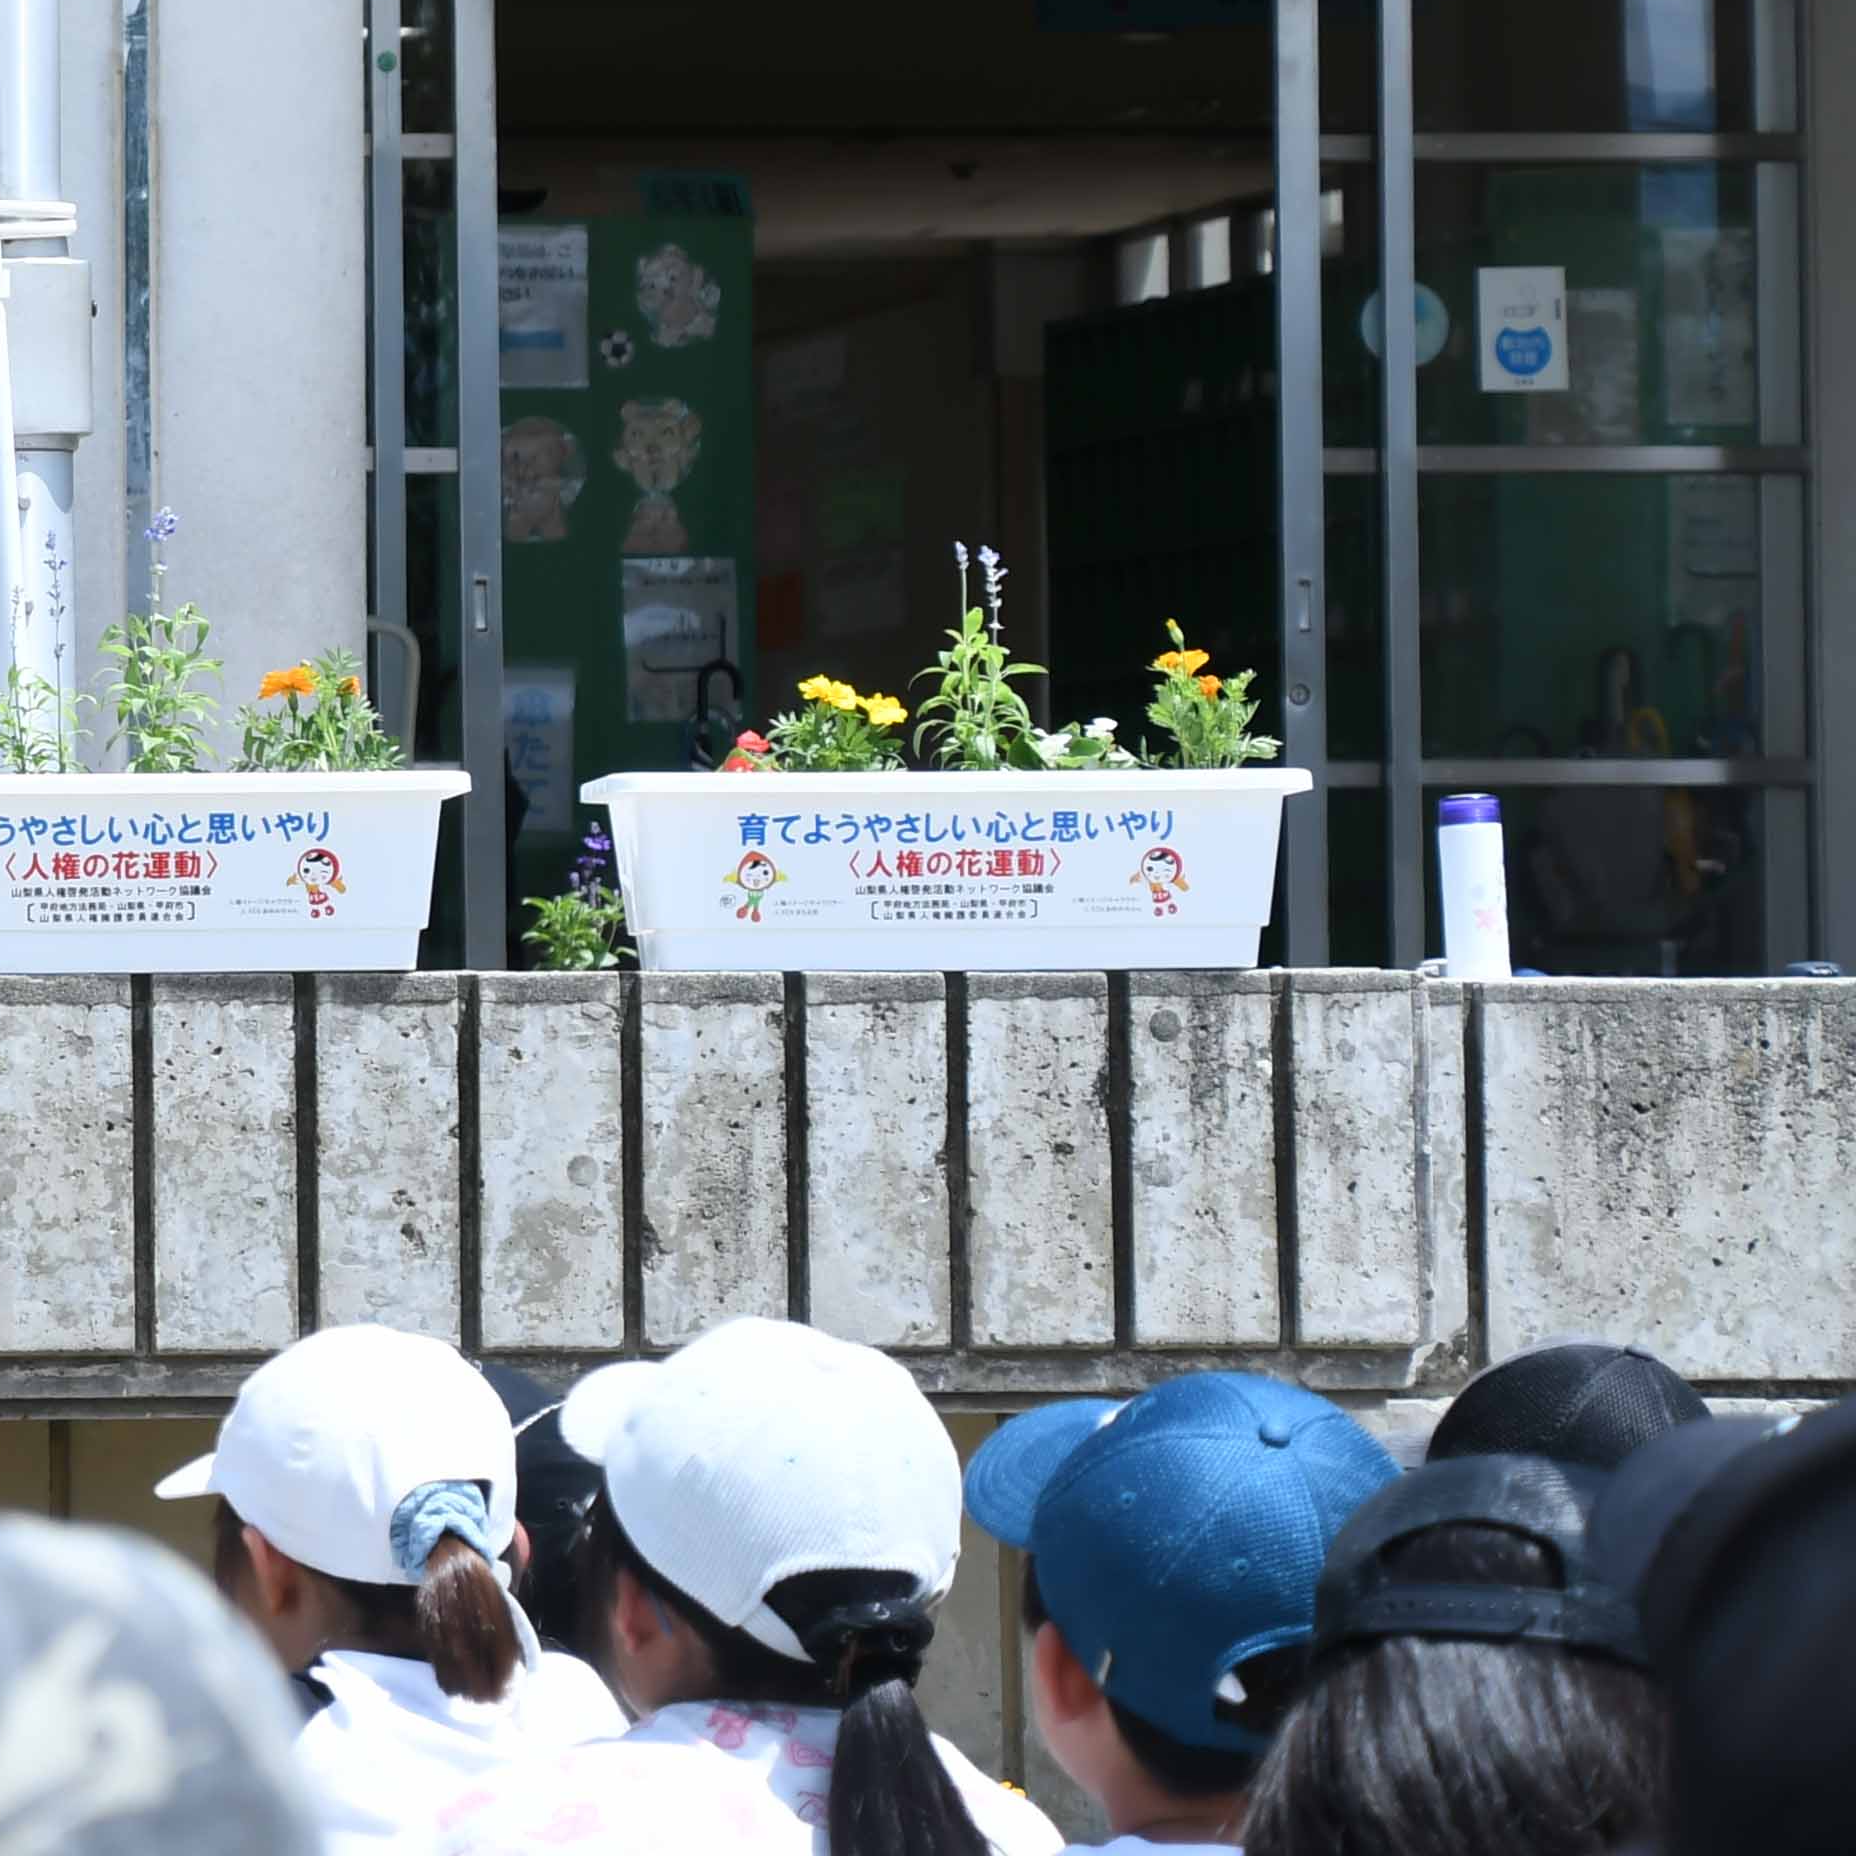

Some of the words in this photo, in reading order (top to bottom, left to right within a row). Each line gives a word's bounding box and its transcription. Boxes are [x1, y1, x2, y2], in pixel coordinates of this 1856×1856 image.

[737, 809, 1175, 846] 育てようやさしい心と思いやり
